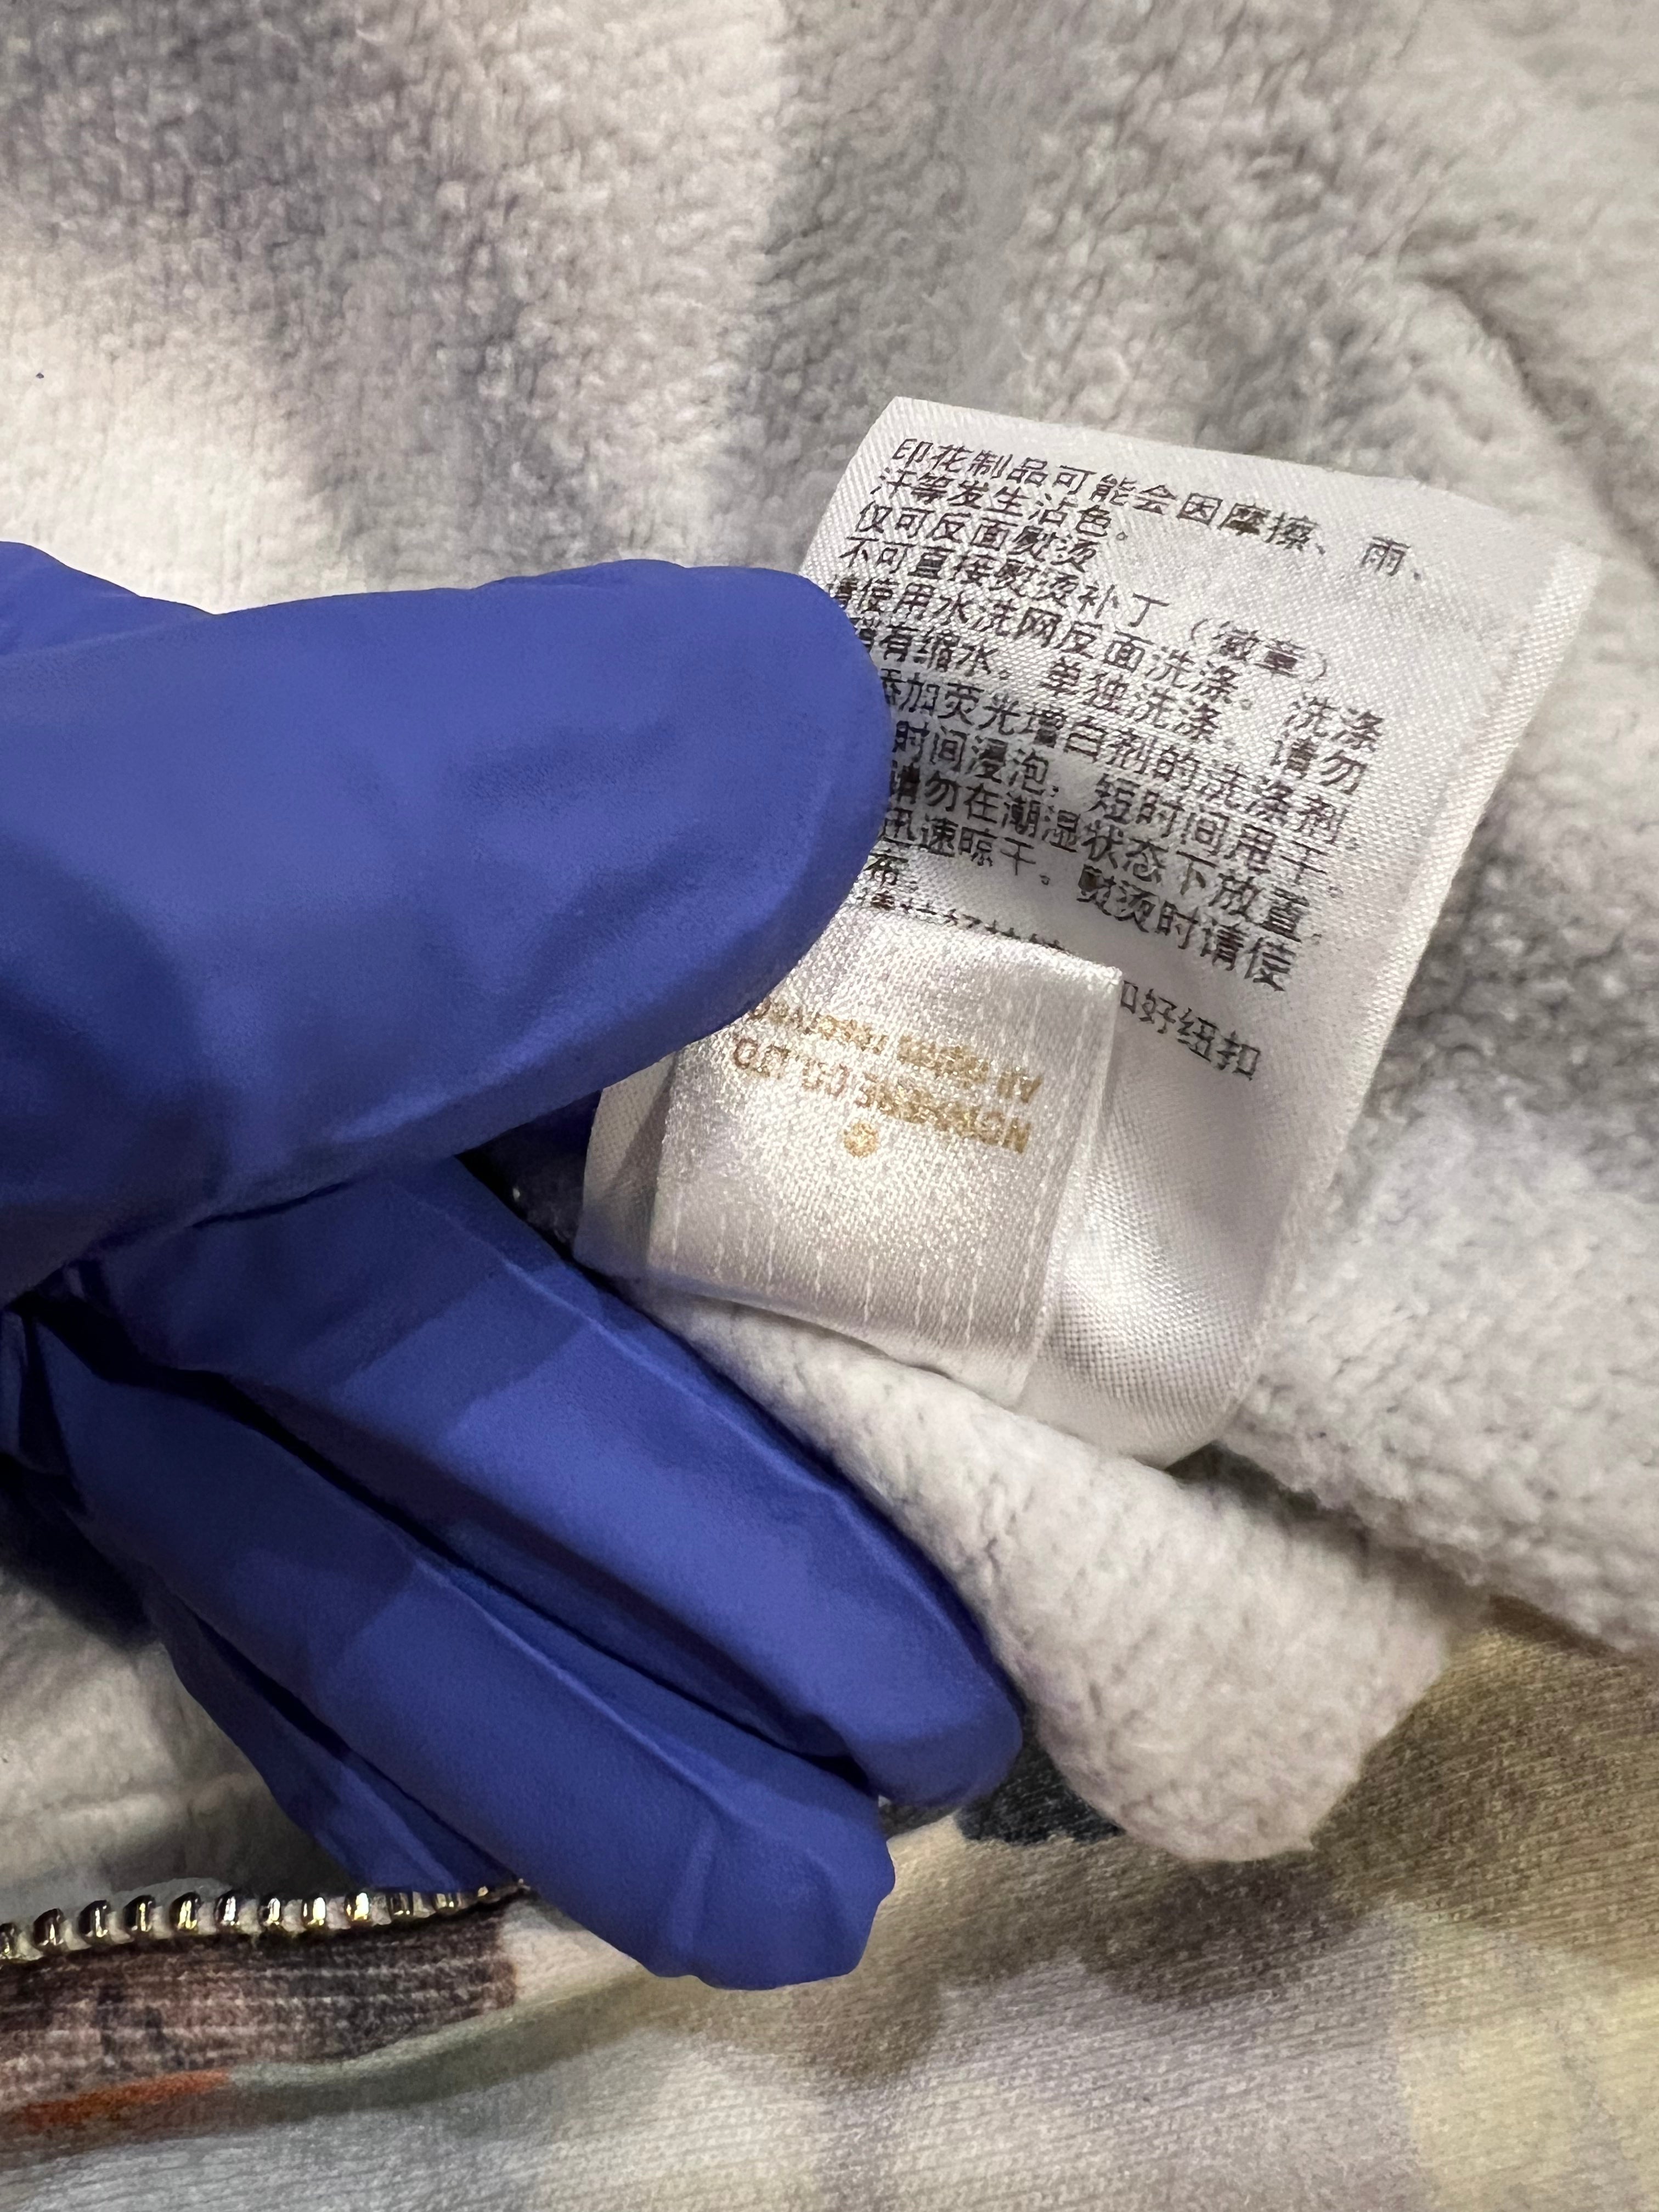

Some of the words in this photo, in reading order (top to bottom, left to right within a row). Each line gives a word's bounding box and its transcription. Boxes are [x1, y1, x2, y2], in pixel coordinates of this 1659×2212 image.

[855, 499, 1099, 573] 仅可反面熨烫
[870, 467, 1128, 542] 汗等发生沾色。
